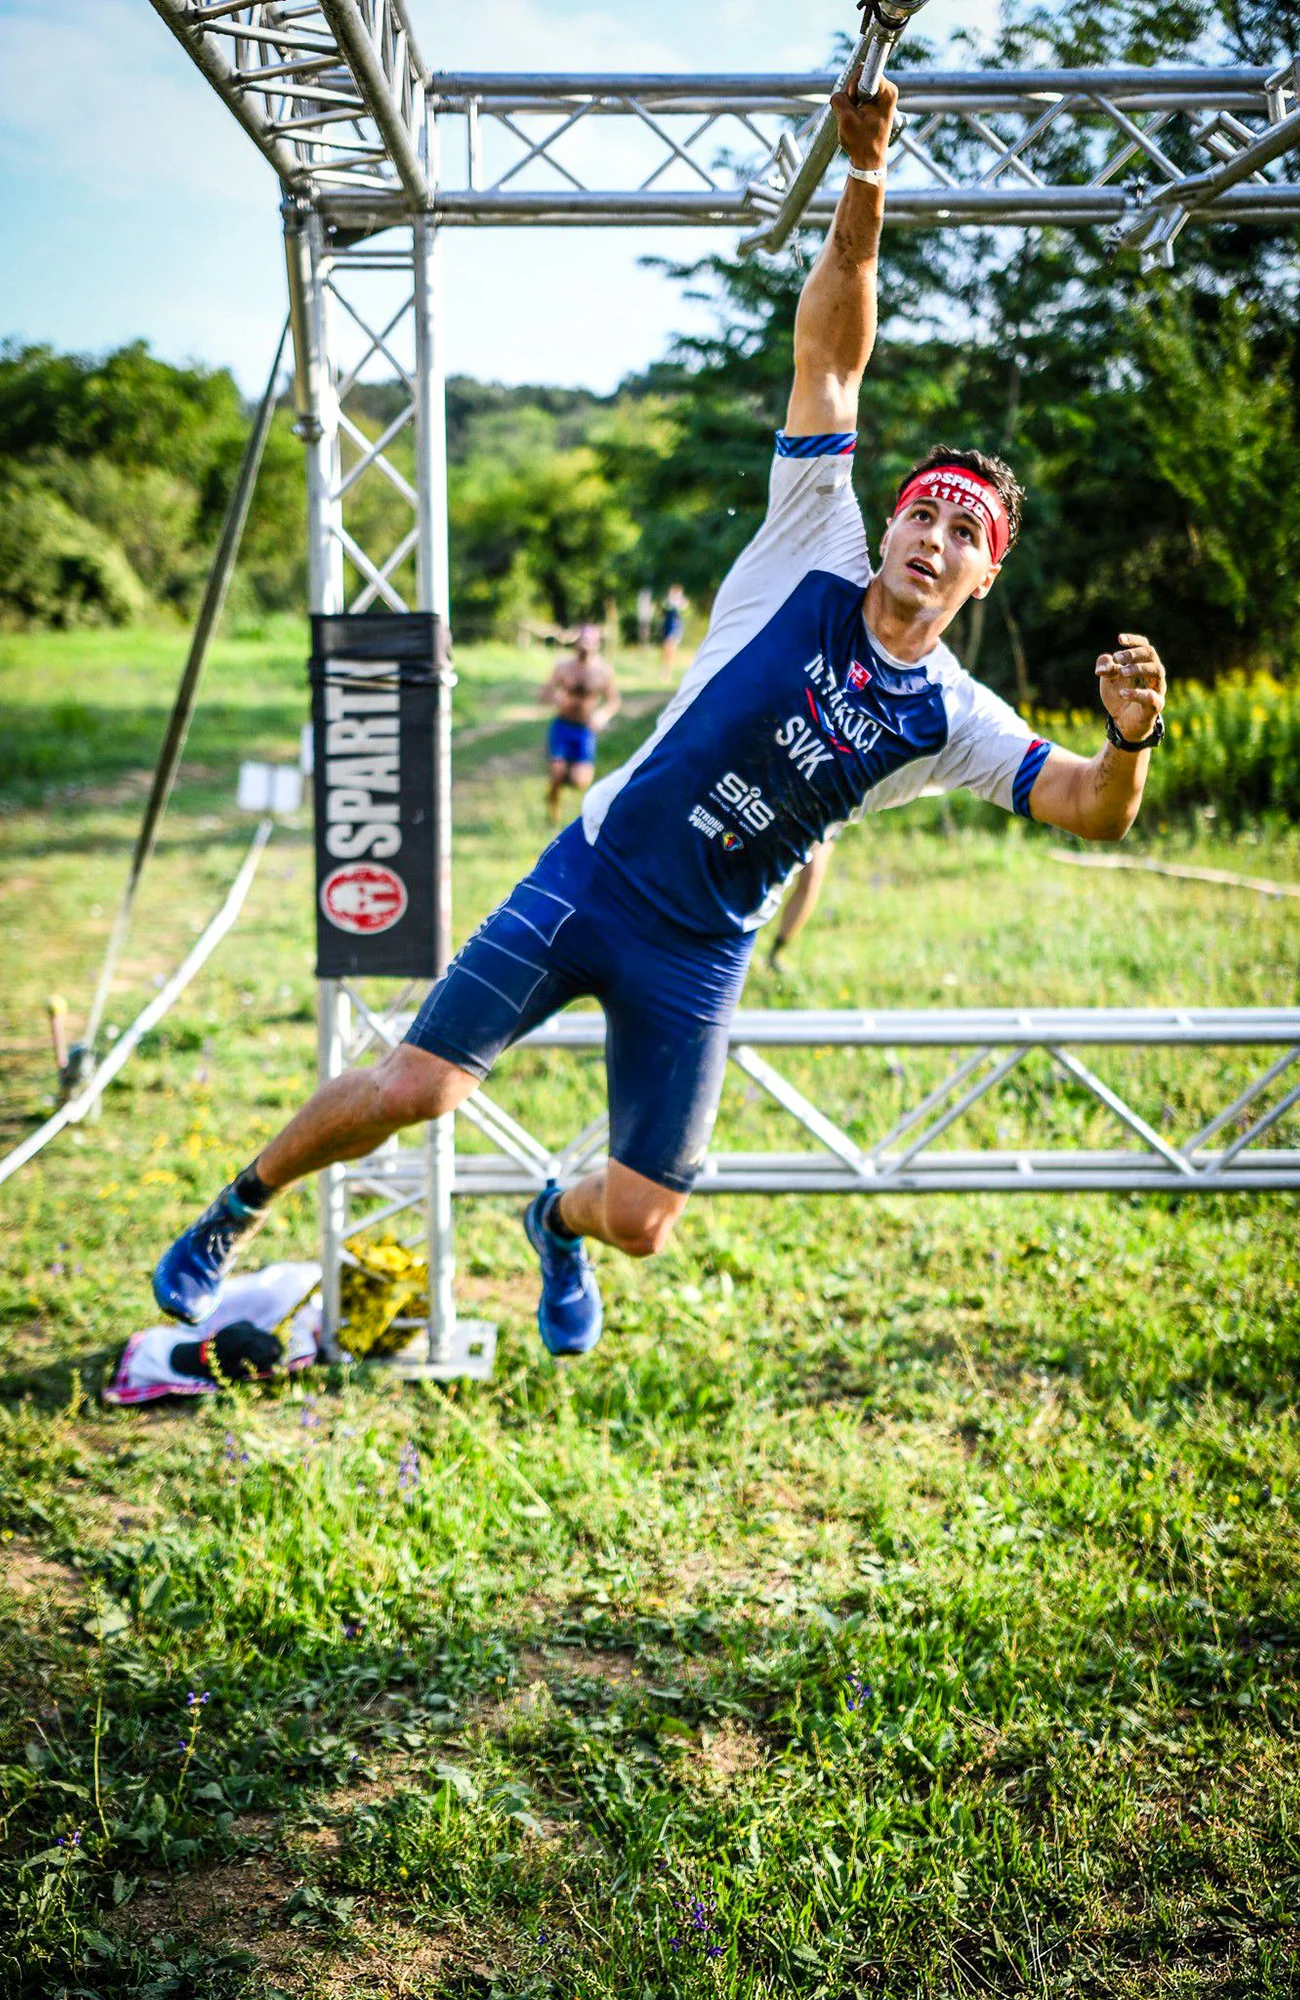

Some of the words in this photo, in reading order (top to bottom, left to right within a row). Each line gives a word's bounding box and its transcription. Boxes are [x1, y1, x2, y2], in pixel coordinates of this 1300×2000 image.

[775, 716, 834, 781] SVK
[688, 814, 717, 839] POWER
[692, 805, 725, 832] STRONG
